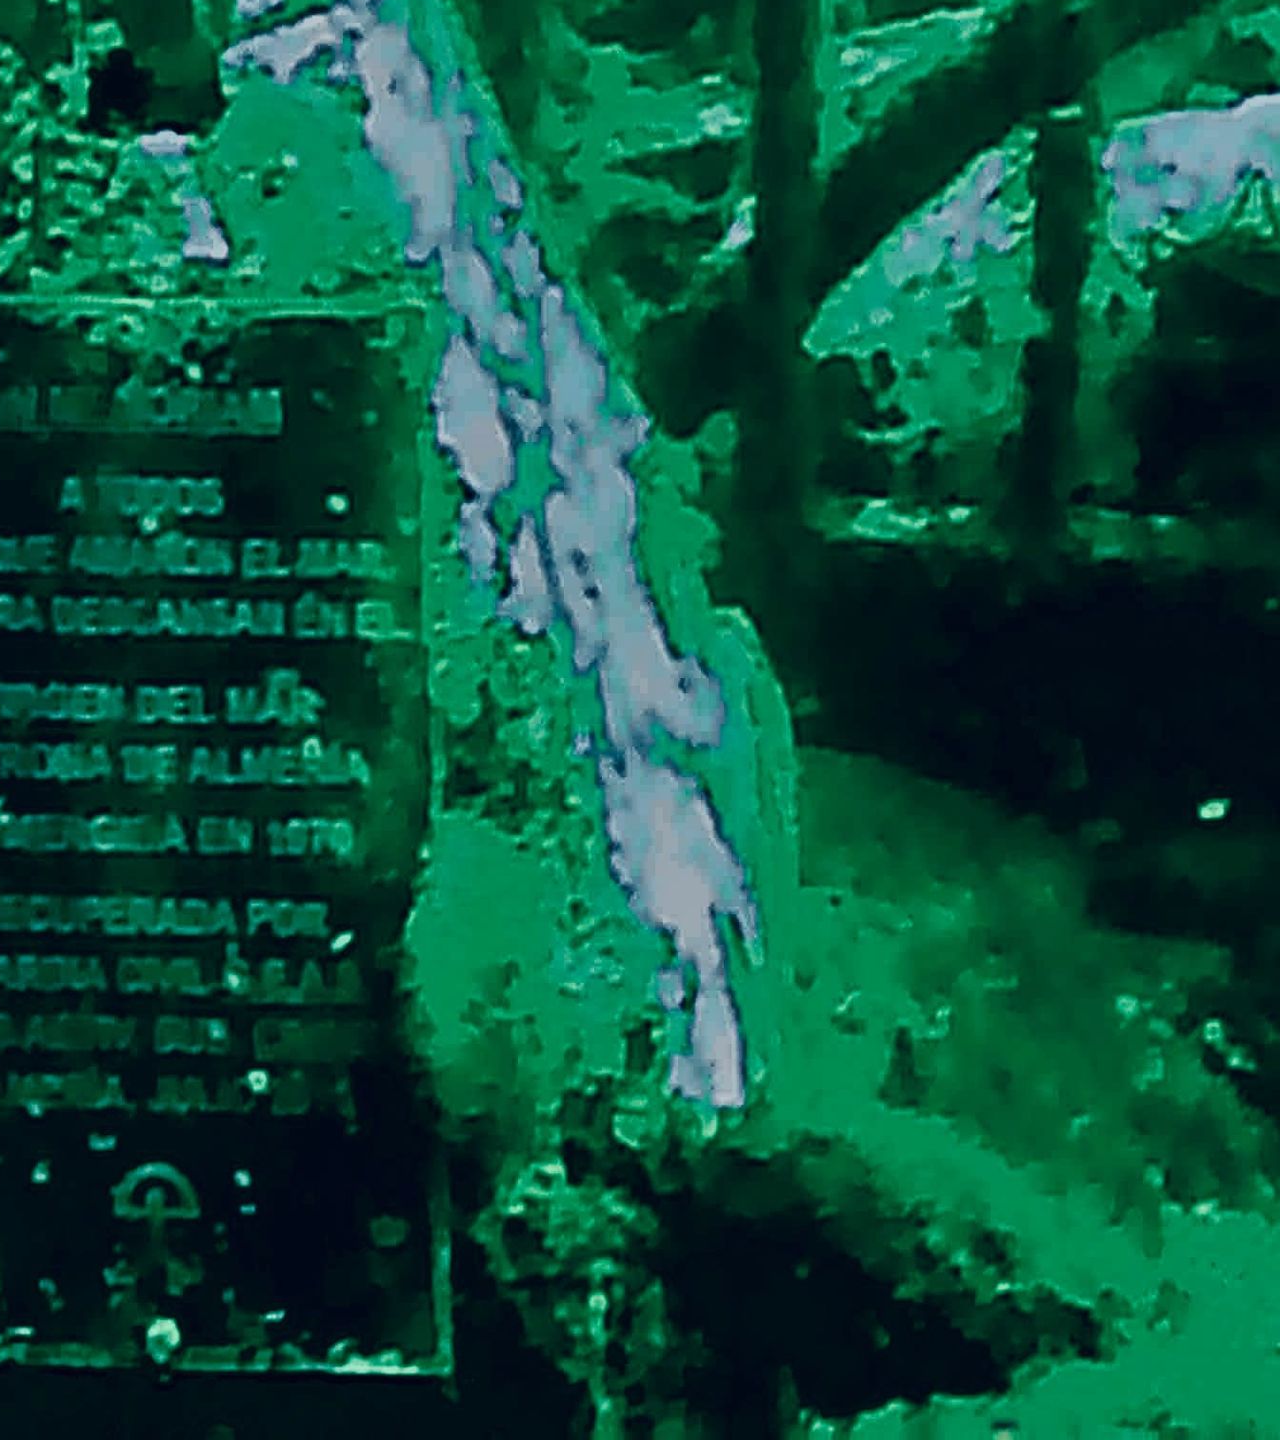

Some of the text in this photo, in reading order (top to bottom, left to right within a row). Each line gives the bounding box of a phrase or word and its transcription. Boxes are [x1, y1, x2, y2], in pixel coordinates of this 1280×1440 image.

[60, 475, 225, 518] A TODOS
[241, 538, 290, 579] EL
[52, 597, 284, 636] DESCANSAN
[135, 684, 215, 725] DEL
[121, 744, 178, 784] DE
[198, 815, 252, 853] EN
